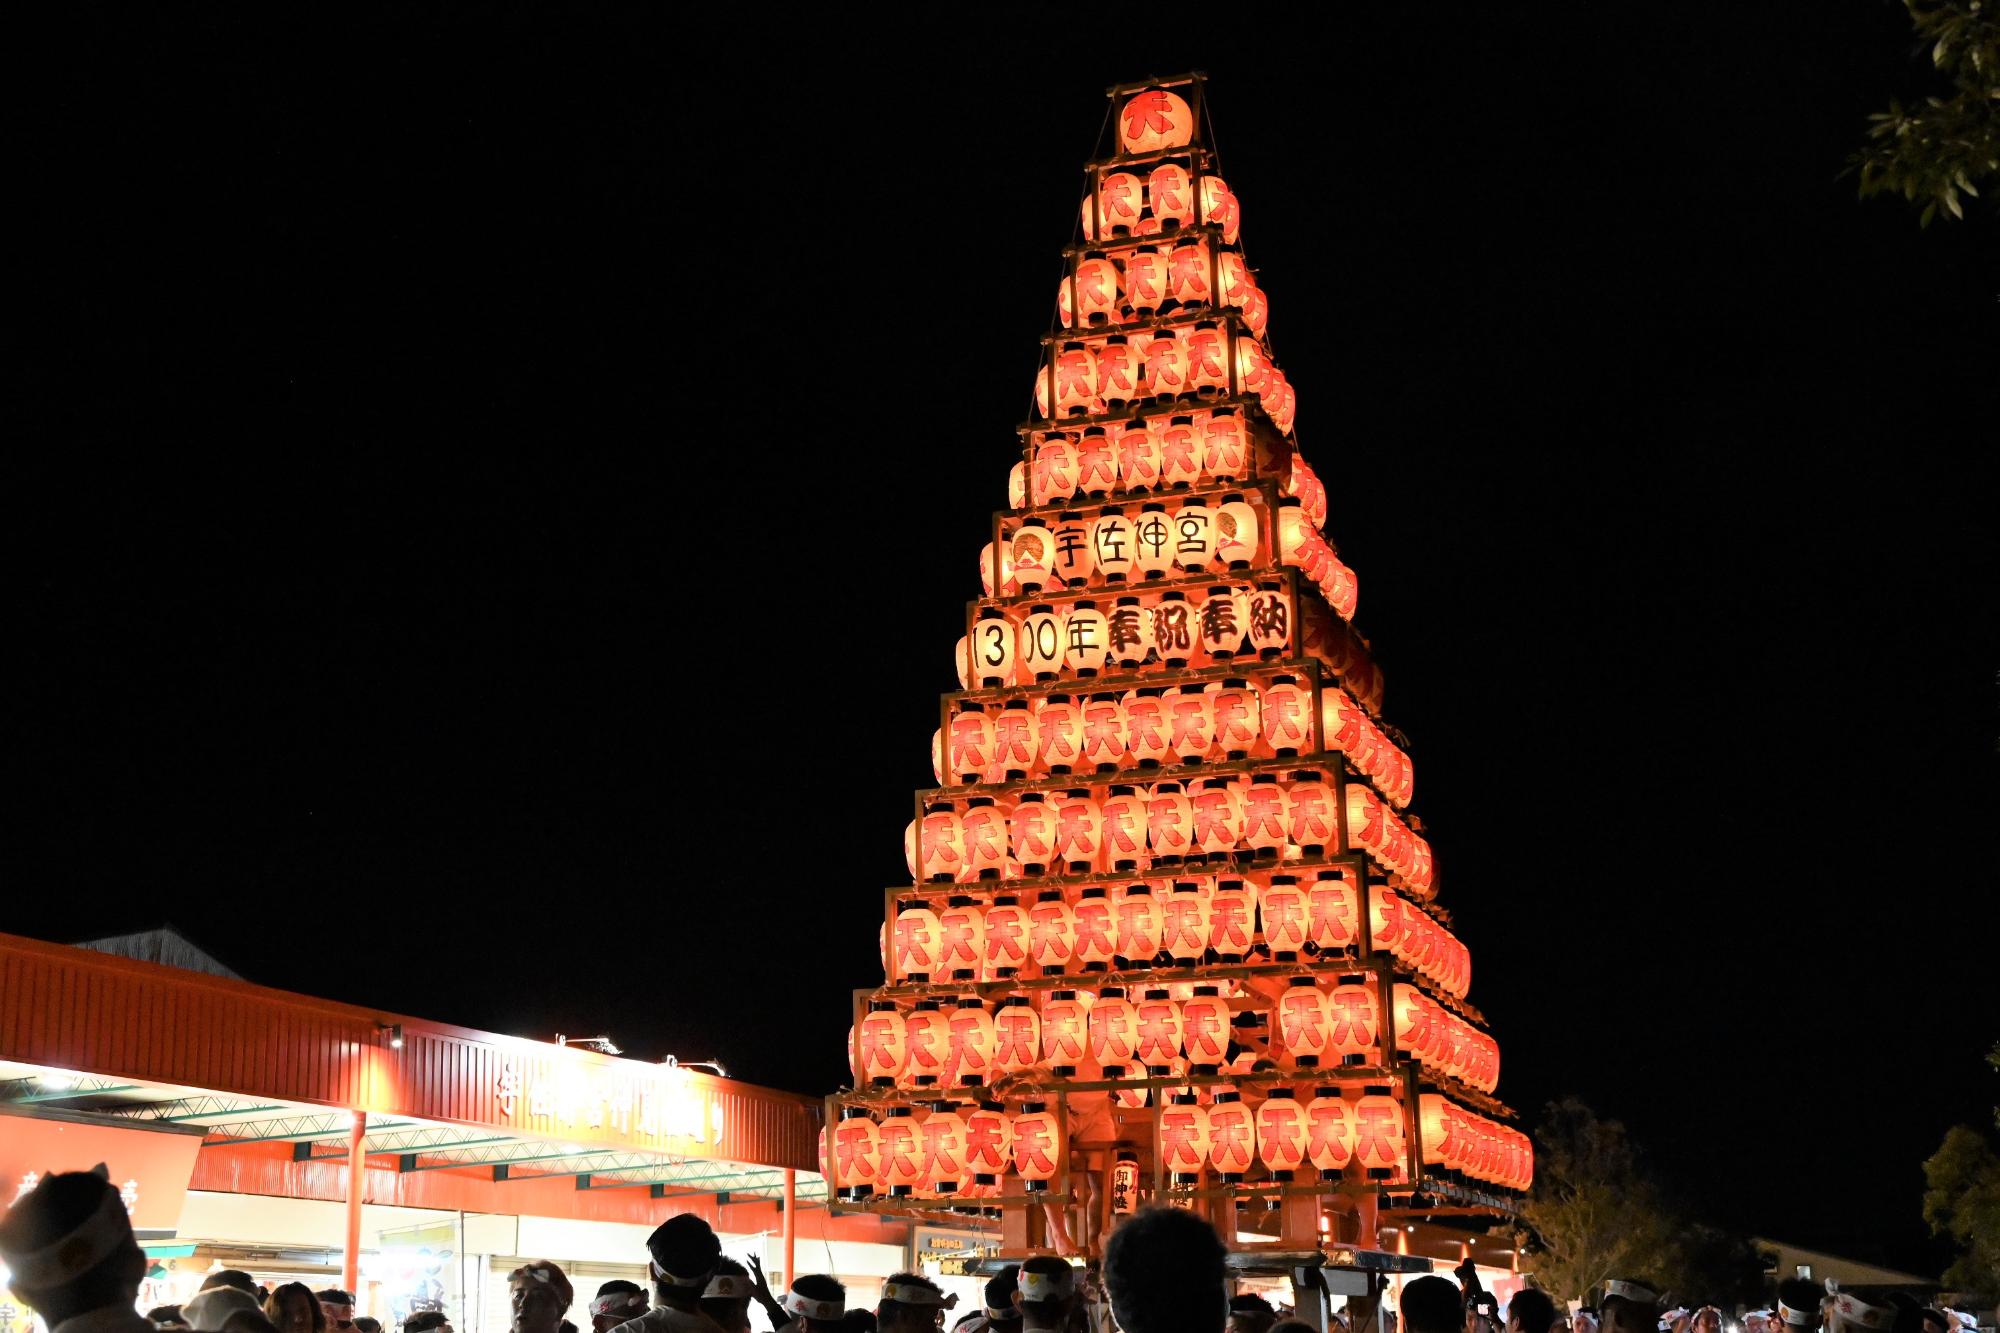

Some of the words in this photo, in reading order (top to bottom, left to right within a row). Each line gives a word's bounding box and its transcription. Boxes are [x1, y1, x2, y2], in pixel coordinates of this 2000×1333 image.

[1124, 90, 1174, 139] 天
[1103, 175, 1136, 218] 天
[1150, 169, 1183, 210] 天
[1077, 265, 1108, 305] 天
[1127, 256, 1158, 299] 天
[1170, 249, 1206, 293] 天
[1058, 352, 1090, 398] 天
[1098, 349, 1132, 390] 天
[1145, 342, 1181, 385] 天
[1187, 333, 1222, 377] 天
[1038, 445, 1070, 491] 天
[1078, 435, 1113, 484] 天
[1118, 432, 1153, 482] 天
[1162, 430, 1197, 474] 天
[1204, 422, 1240, 469] 天
[1054, 511, 1209, 568] 宇佐神宮
[1039, 710, 1074, 757] 天
[1084, 708, 1124, 756] 天
[1127, 703, 1163, 752] 天
[1171, 702, 1208, 749] 天
[1214, 696, 1253, 743] 天
[1262, 691, 1300, 739] 天
[952, 719, 985, 768] 天
[996, 716, 1031, 764] 天
[1012, 807, 1048, 857] 天
[1058, 805, 1094, 853] 天
[1102, 803, 1136, 852] 天
[1150, 799, 1185, 847] 天
[1194, 793, 1234, 844] 天
[1245, 789, 1285, 838] 天
[1289, 789, 1328, 838] 天
[923, 816, 958, 864] 天
[962, 813, 999, 864] 天
[940, 915, 977, 962] 天
[985, 911, 1024, 960] 天
[1030, 907, 1070, 959] 天
[1074, 904, 1115, 955] 天
[1118, 902, 1153, 956] 天
[1164, 900, 1202, 948] 天
[1210, 898, 1248, 946] 天
[1264, 894, 1303, 943] 天
[1309, 890, 1348, 941] 天
[896, 918, 931, 966] 天
[863, 1019, 896, 1069] 天
[905, 1017, 938, 1067] 天
[995, 1016, 1033, 1065] 天
[1043, 1007, 1080, 1059] 天
[1090, 1006, 1129, 1057] 天
[1136, 1006, 1179, 1058] 天
[1184, 1005, 1219, 1056] 天
[1283, 995, 1324, 1048] 天
[1332, 993, 1372, 1046] 天
[949, 1018, 985, 1074] 天
[838, 1128, 875, 1177] 天
[879, 1126, 918, 1176] 天
[922, 1122, 958, 1173] 天
[966, 1116, 1002, 1167] 天
[1013, 1120, 1054, 1172] 天
[1163, 1114, 1200, 1164] 天
[1210, 1112, 1249, 1164] 天
[1258, 1109, 1301, 1163] 天
[1307, 1107, 1347, 1161] 天
[1355, 1107, 1397, 1162] 天
